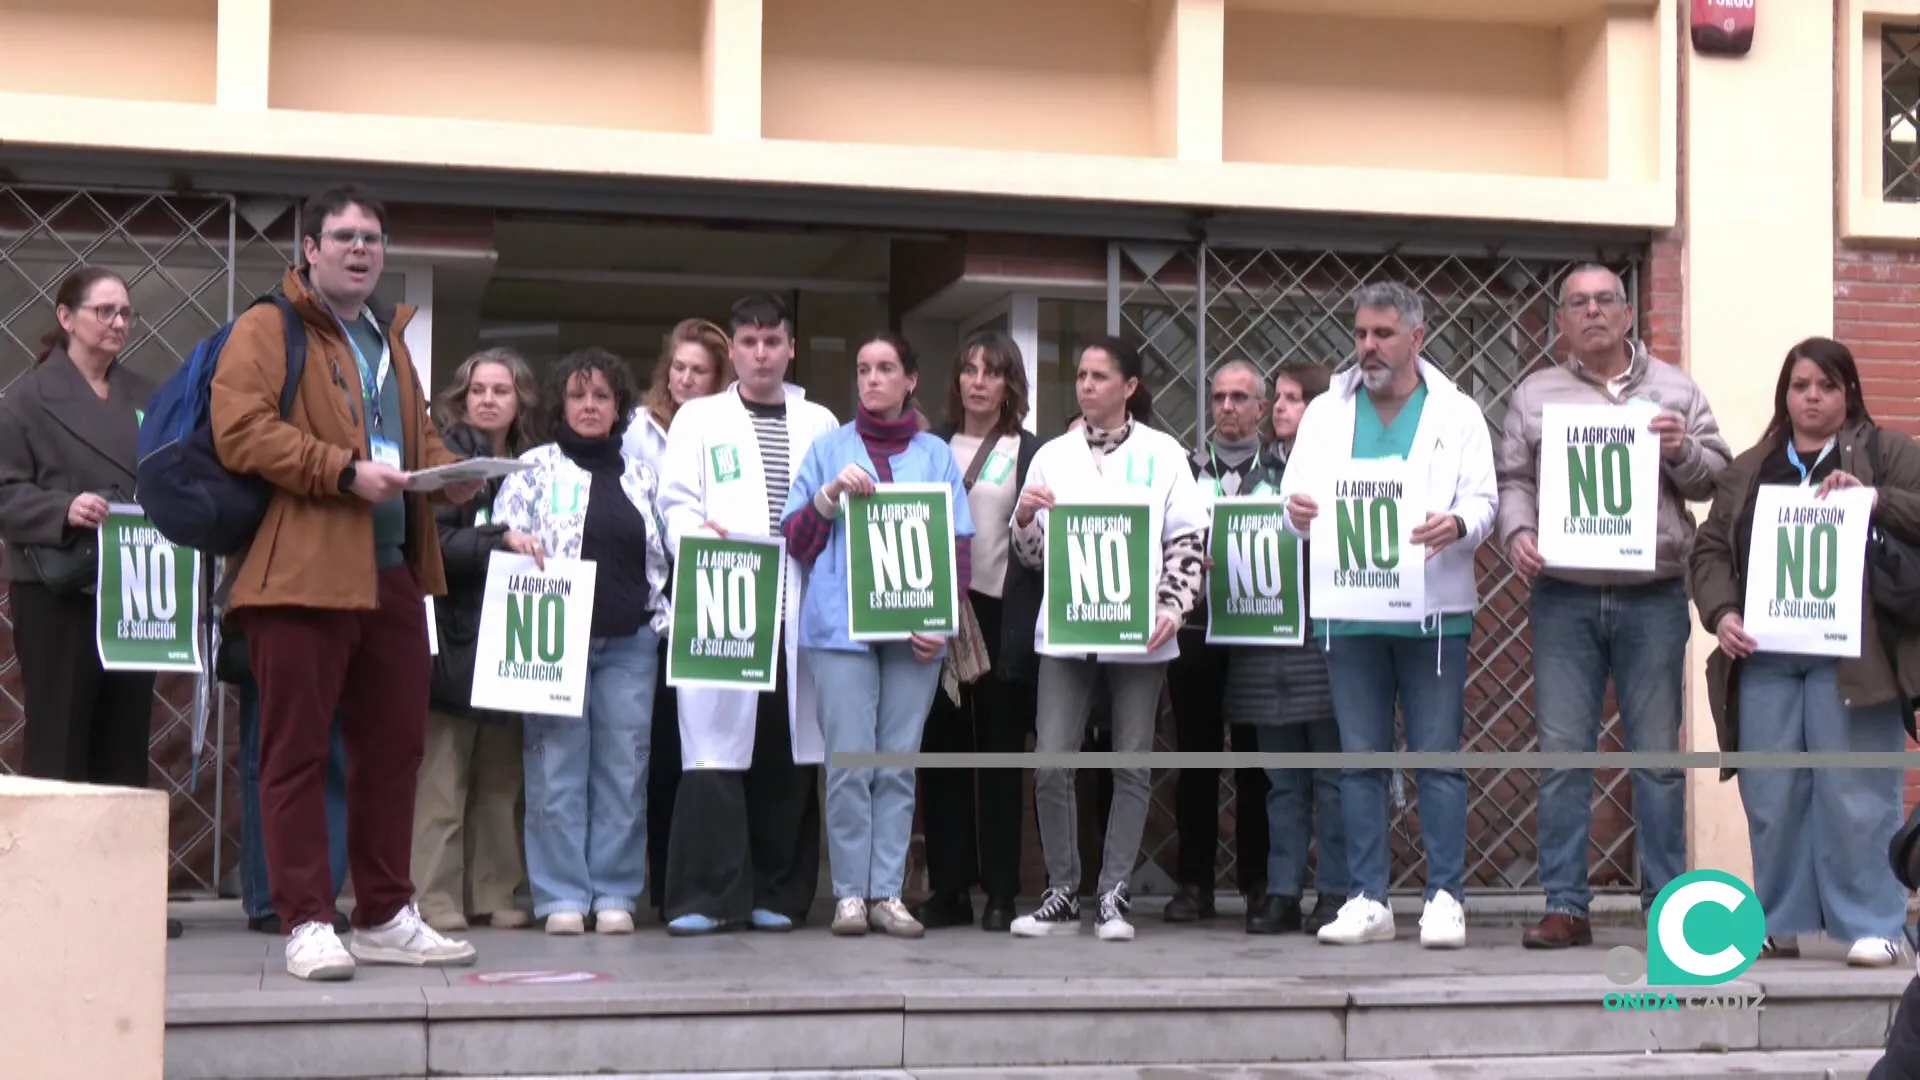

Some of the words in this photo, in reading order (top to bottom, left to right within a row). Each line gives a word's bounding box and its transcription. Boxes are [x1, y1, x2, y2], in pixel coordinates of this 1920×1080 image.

[1567, 425, 1579, 444] LA
[1582, 424, 1635, 445] AGRESIÓN
[1336, 479, 1347, 498] LA
[1351, 479, 1403, 499] AGRESIÓN
[1567, 442, 1632, 517] NO
[867, 504, 880, 521] LA
[881, 500, 930, 521] AGRESIÓN
[1778, 506, 1790, 524] LA
[1793, 506, 1845, 525] AGRESIÓN
[1067, 516, 1080, 534] LA
[1081, 513, 1132, 534] AGRESIÓN
[1228, 514, 1239, 532] LA
[1240, 512, 1283, 532] AGRESIÓN
[1564, 516, 1576, 534] ES
[1579, 516, 1632, 536] SOLUCIÓN
[119, 525, 131, 544] LA
[1336, 497, 1399, 571] NO
[697, 549, 708, 567] LA
[710, 550, 761, 571] AGRESIÓN
[867, 519, 933, 593] NO
[1227, 529, 1282, 600] NO
[1776, 523, 1837, 600] NO
[1067, 533, 1131, 604] NO
[1334, 569, 1346, 587] ES
[1349, 569, 1400, 589] SOLUCIÓN
[120, 544, 176, 621] NO
[508, 575, 519, 592] LA
[521, 575, 571, 596] AGRESIÓN
[696, 567, 757, 640] NO
[870, 590, 883, 609] ES
[884, 589, 934, 609] SOLUCIÓN
[1226, 598, 1238, 615] ES
[1239, 597, 1283, 615] SOLUCIÓN
[1769, 599, 1781, 618] ES
[1783, 600, 1836, 620] SOLUCIÓN
[1066, 604, 1079, 621] ES
[1081, 602, 1131, 621] SOLUCIÓN
[117, 620, 129, 638] ES
[131, 619, 176, 640] SOLUCIÓN
[505, 592, 565, 664] NO
[690, 638, 703, 655] ES
[705, 638, 755, 658] SOLUCIÓN
[498, 660, 510, 678] ES
[512, 660, 563, 682] SOLUCIÓN
